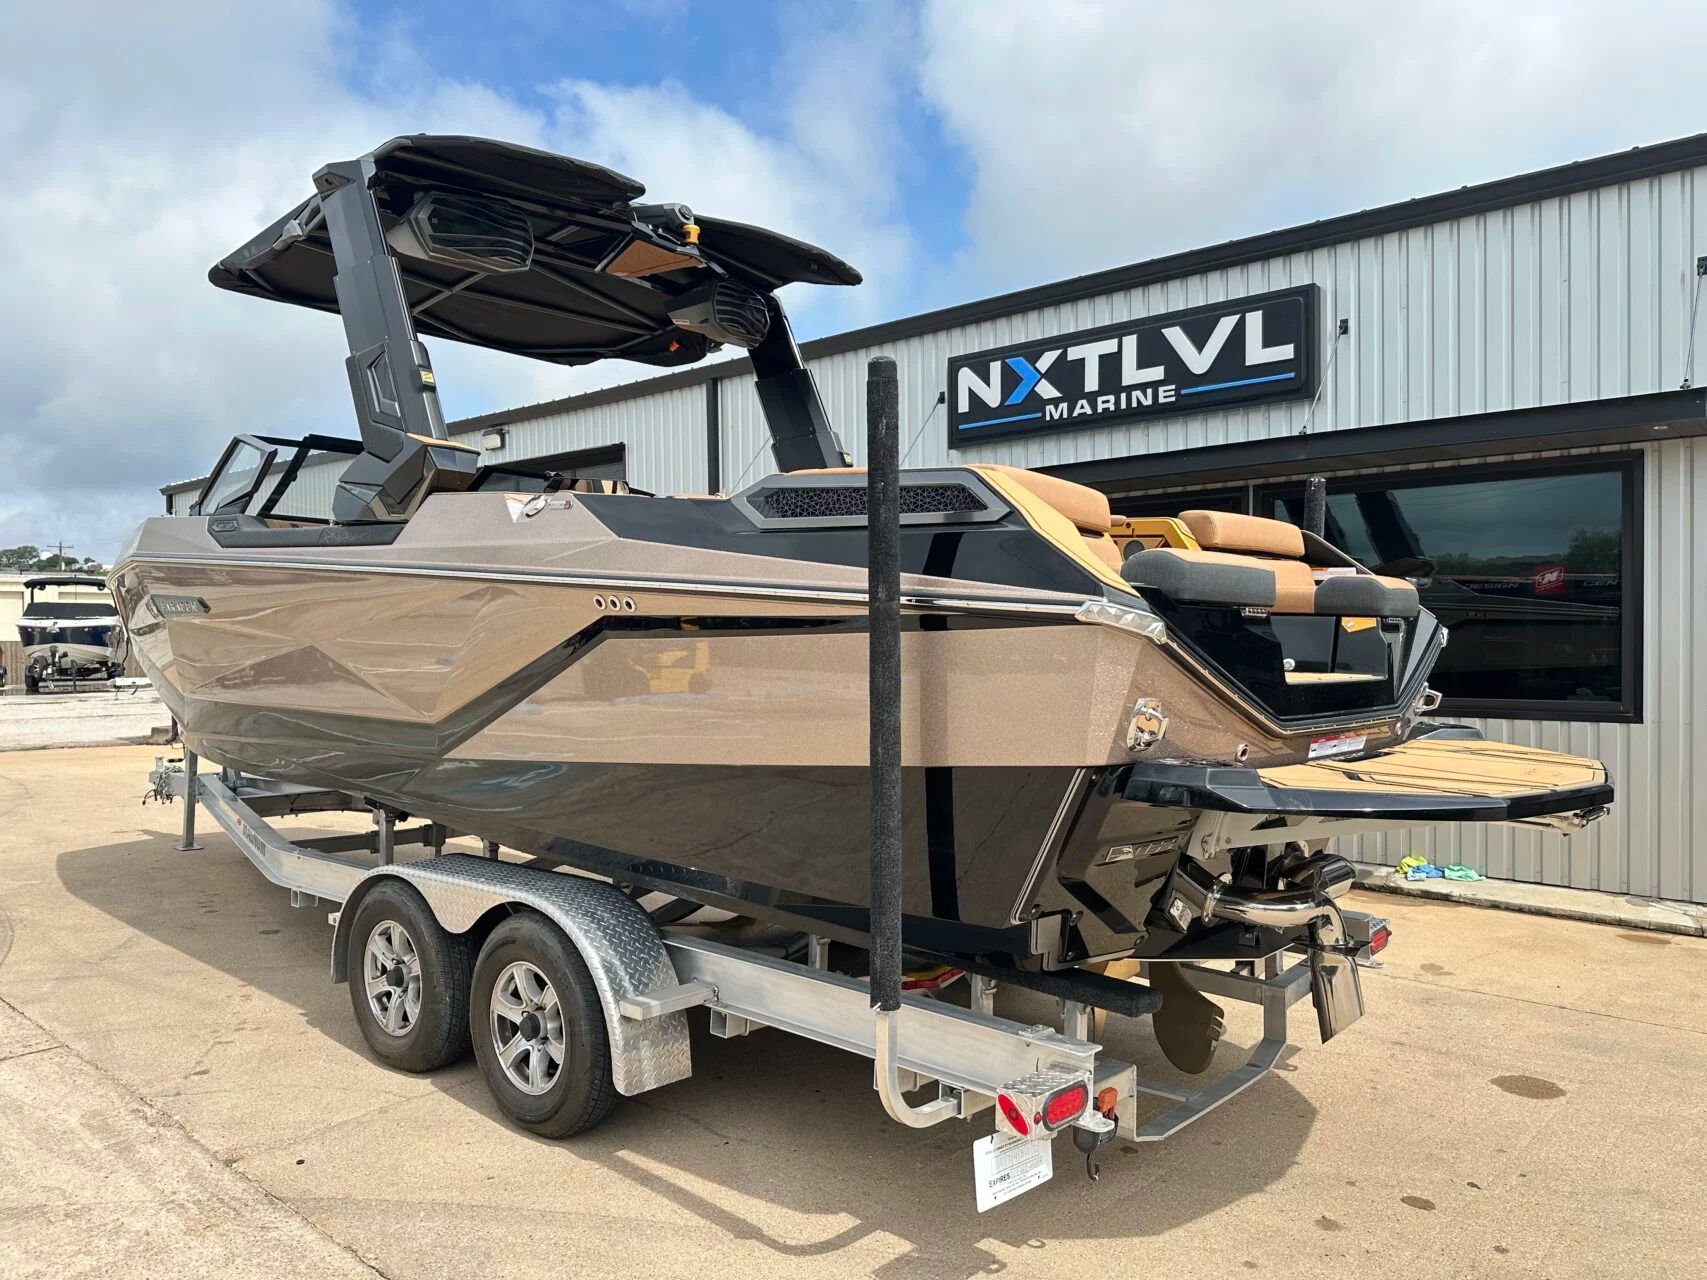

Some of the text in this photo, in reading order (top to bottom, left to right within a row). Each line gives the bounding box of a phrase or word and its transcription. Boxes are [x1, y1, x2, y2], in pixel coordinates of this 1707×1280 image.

[957, 310, 1295, 414] NXTLVL
[1045, 384, 1176, 421] MARINE
[988, 1172, 1011, 1188] EXPIRES
